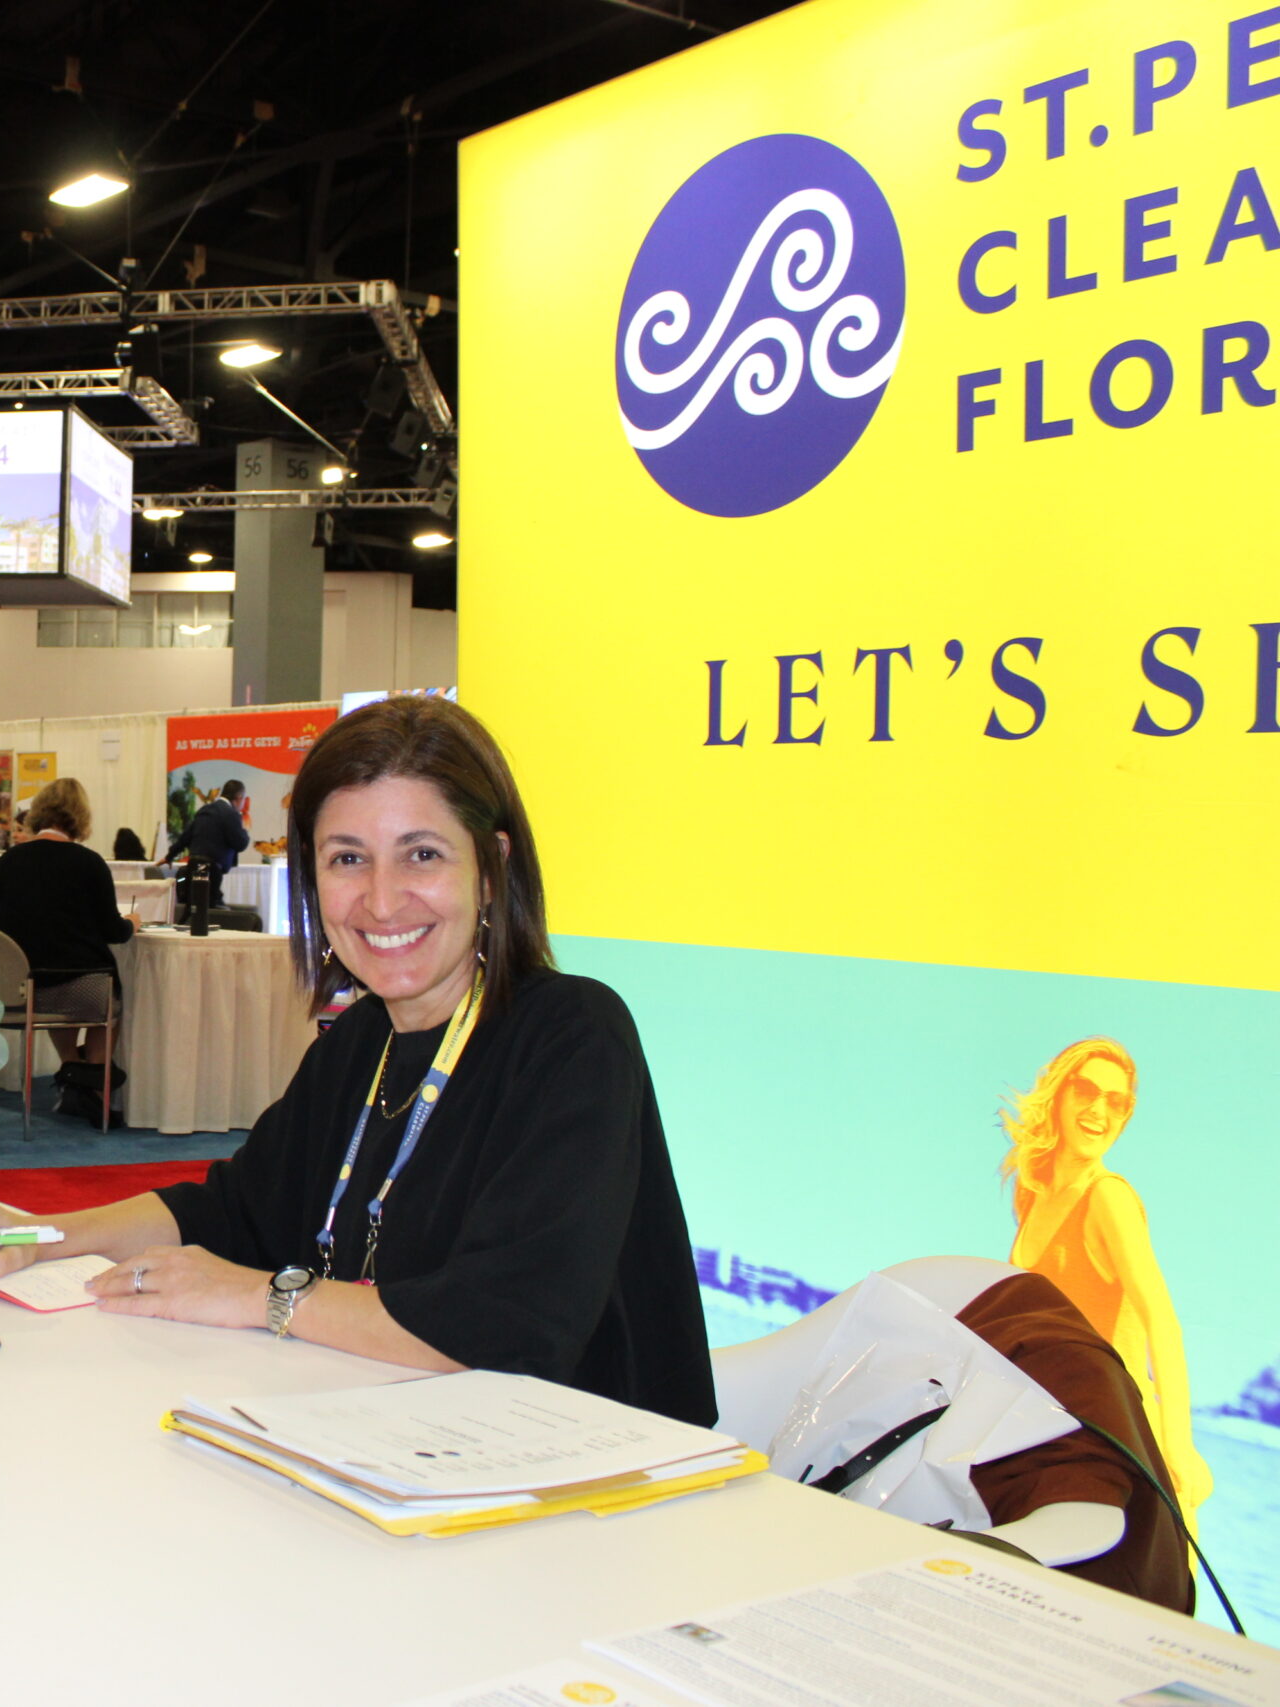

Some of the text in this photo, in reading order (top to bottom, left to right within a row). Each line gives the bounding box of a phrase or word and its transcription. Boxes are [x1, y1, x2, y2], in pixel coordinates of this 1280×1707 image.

[957, 167, 1280, 314] CLEA
[956, 320, 1277, 453] FLOR
[244, 455, 262, 478] 56
[287, 458, 309, 480] 56
[702, 636, 1047, 748] LET'S
[176, 736, 281, 750] AS WILD AS LIFE GETS!
